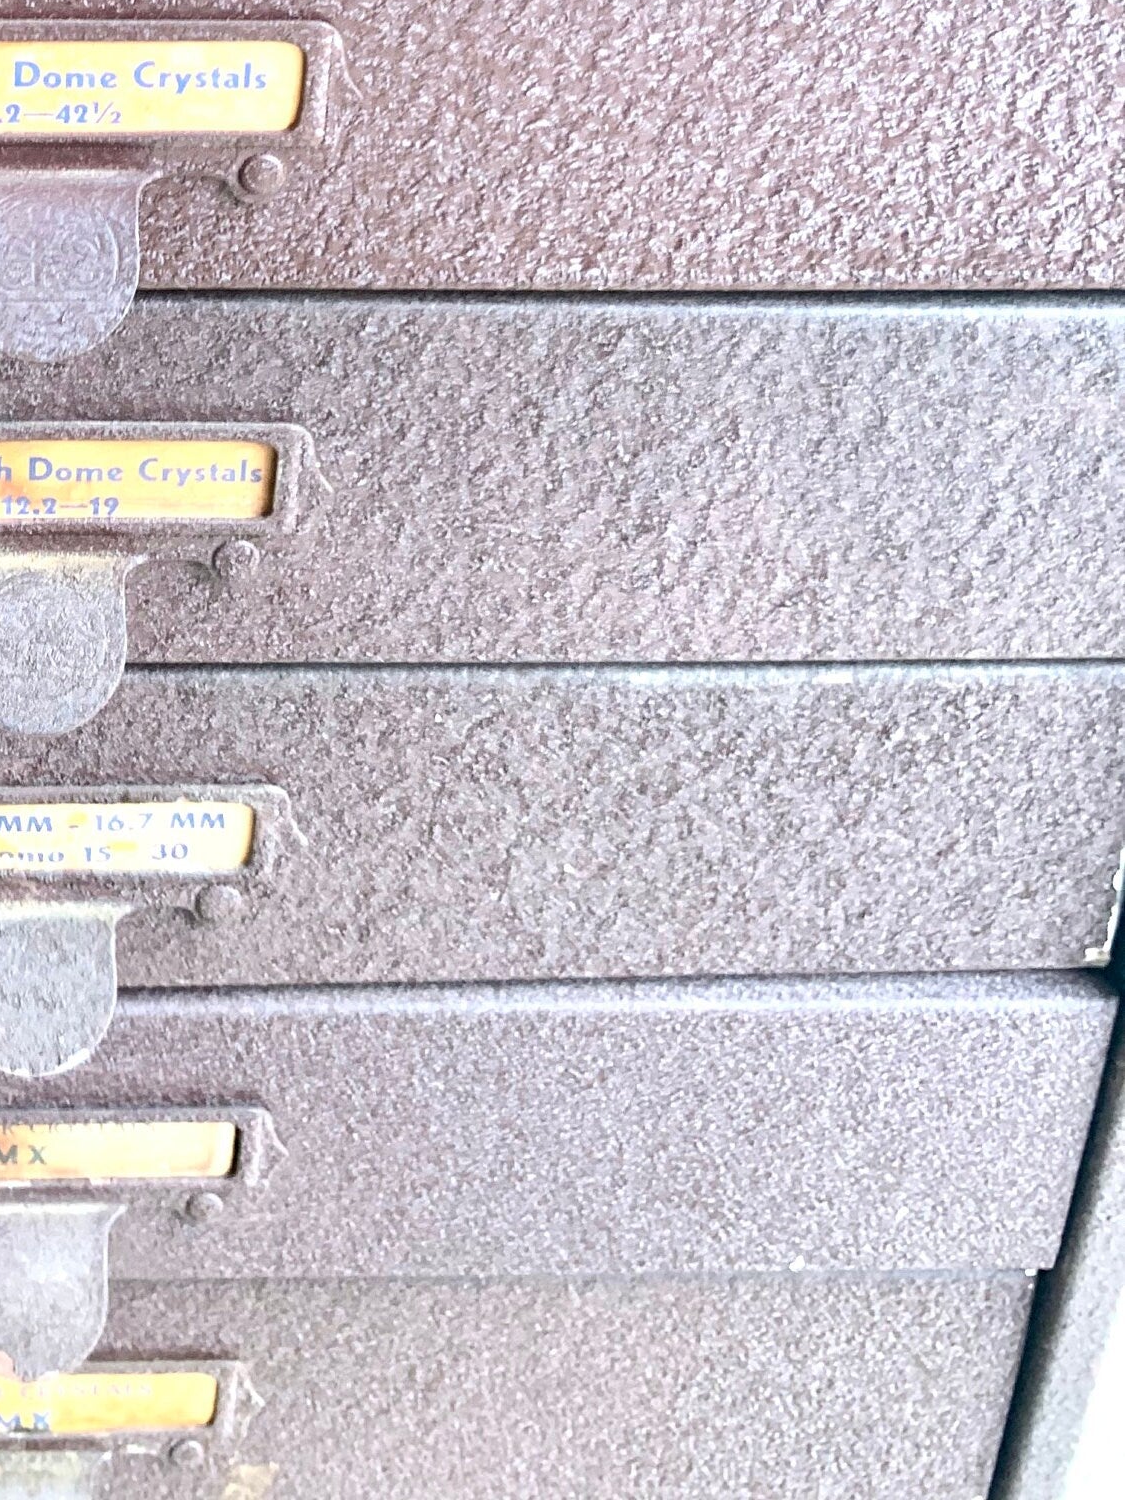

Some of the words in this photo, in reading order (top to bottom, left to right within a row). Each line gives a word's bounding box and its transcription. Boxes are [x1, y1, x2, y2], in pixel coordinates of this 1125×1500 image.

[13, 60, 117, 89] Dome
[133, 60, 267, 95] Crystals
[28, 456, 123, 482] Dome
[138, 457, 263, 487] Crystals
[170, 812, 225, 829] MM
